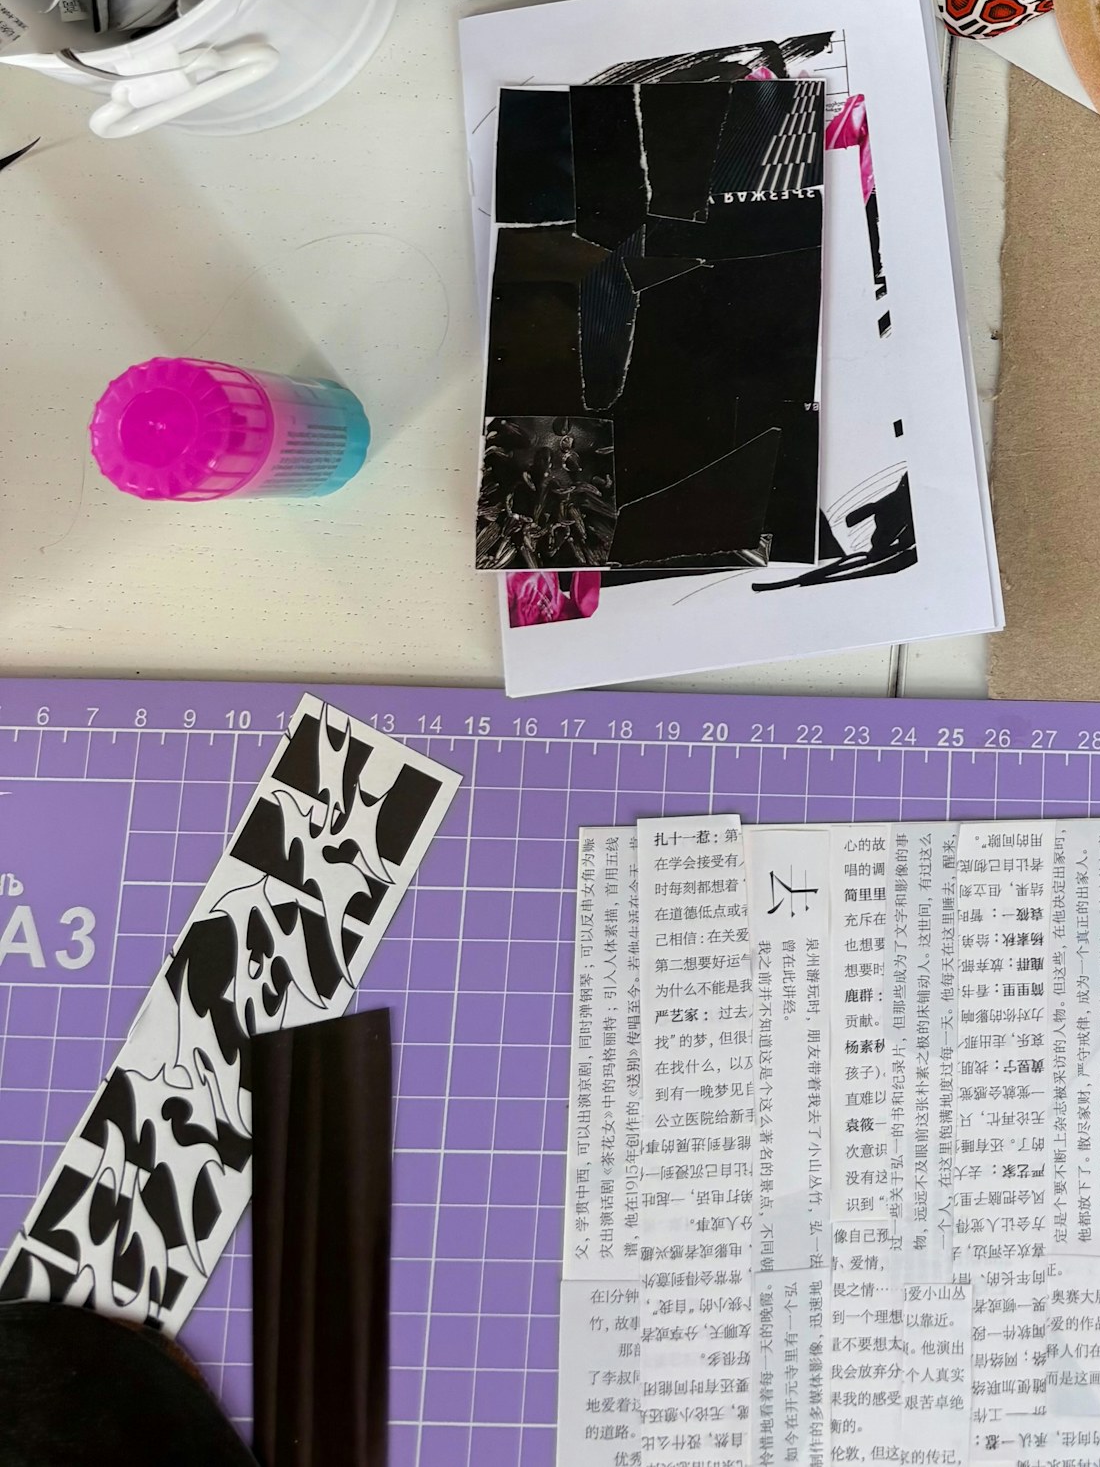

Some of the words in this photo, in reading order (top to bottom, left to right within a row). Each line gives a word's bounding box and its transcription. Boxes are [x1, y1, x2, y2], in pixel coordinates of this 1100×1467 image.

[36, 706, 50, 726] 6
[86, 707, 100, 727] 7
[134, 707, 148, 728] 8
[183, 708, 197, 729] 9
[225, 709, 252, 730] 10
[369, 713, 395, 733] 13
[417, 714, 443, 734] 14
[464, 715, 491, 736] 15
[512, 717, 538, 737] 16
[560, 718, 586, 738] 17
[607, 719, 633, 740] 18
[655, 721, 681, 741] 19
[701, 722, 729, 742] 20
[749, 723, 775, 743] 21
[795, 724, 823, 744] 22
[843, 725, 870, 745] 23
[890, 726, 917, 746] 24
[936, 727, 965, 747] 25
[984, 728, 1011, 748] 26
[1030, 729, 1058, 749] 27
[844, 887, 886, 903] 简里里
[844, 1014, 882, 1028] 贡献。
[585, 1425, 636, 1440] 的道路。
